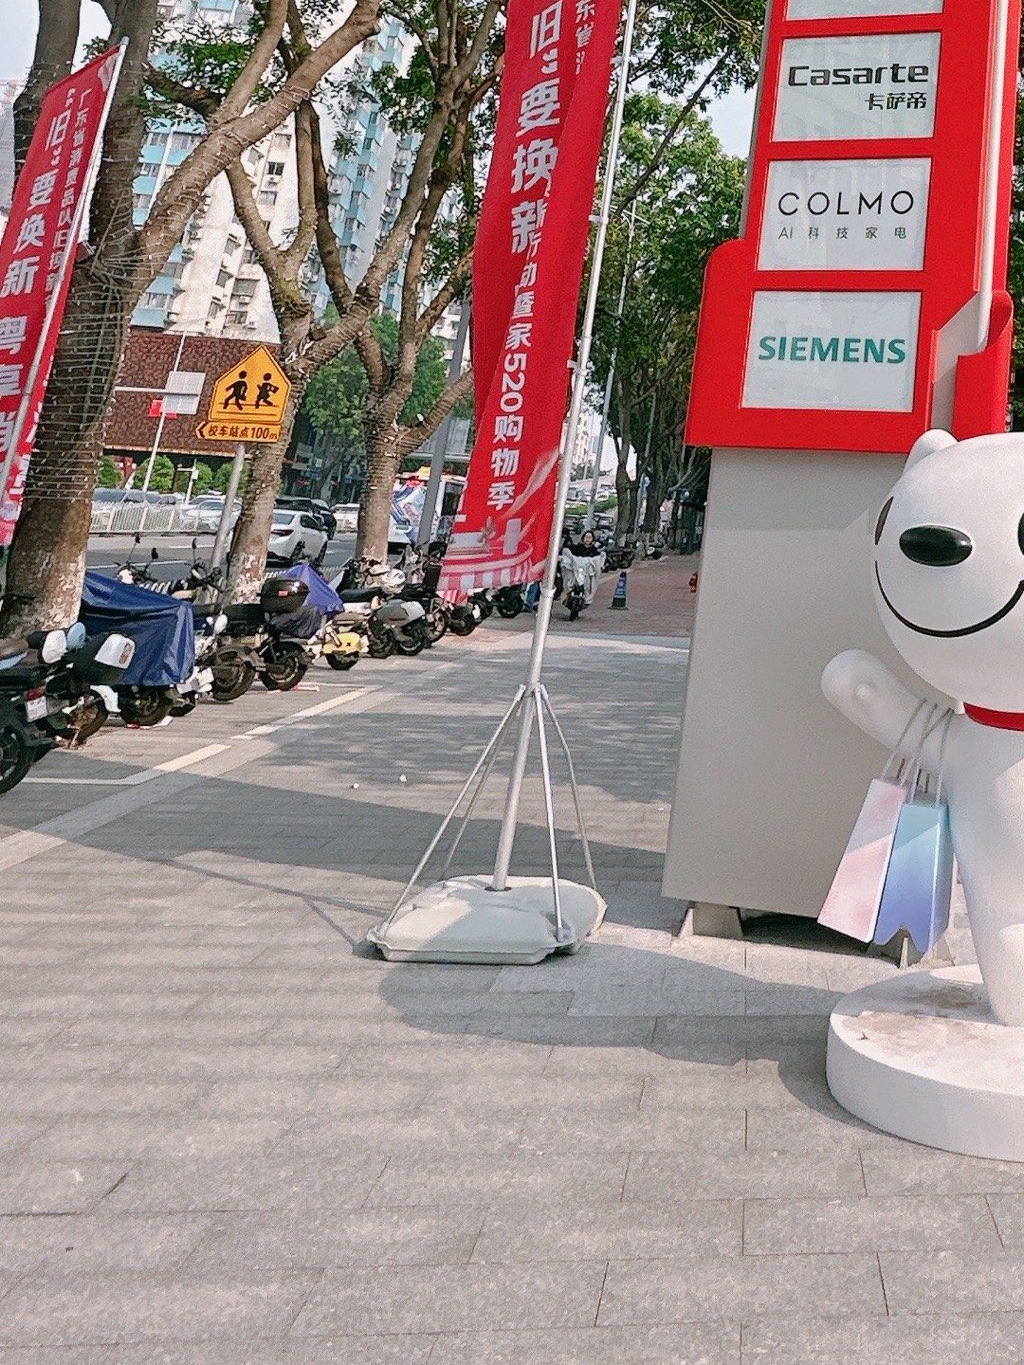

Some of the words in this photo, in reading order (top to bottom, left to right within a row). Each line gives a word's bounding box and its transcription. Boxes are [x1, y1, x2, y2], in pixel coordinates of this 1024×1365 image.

[788, 63, 929, 86] Casarte
[865, 91, 927, 110] 卡萨帝
[778, 190, 914, 215] COLMO
[758, 336, 906, 364] SIEMENS
